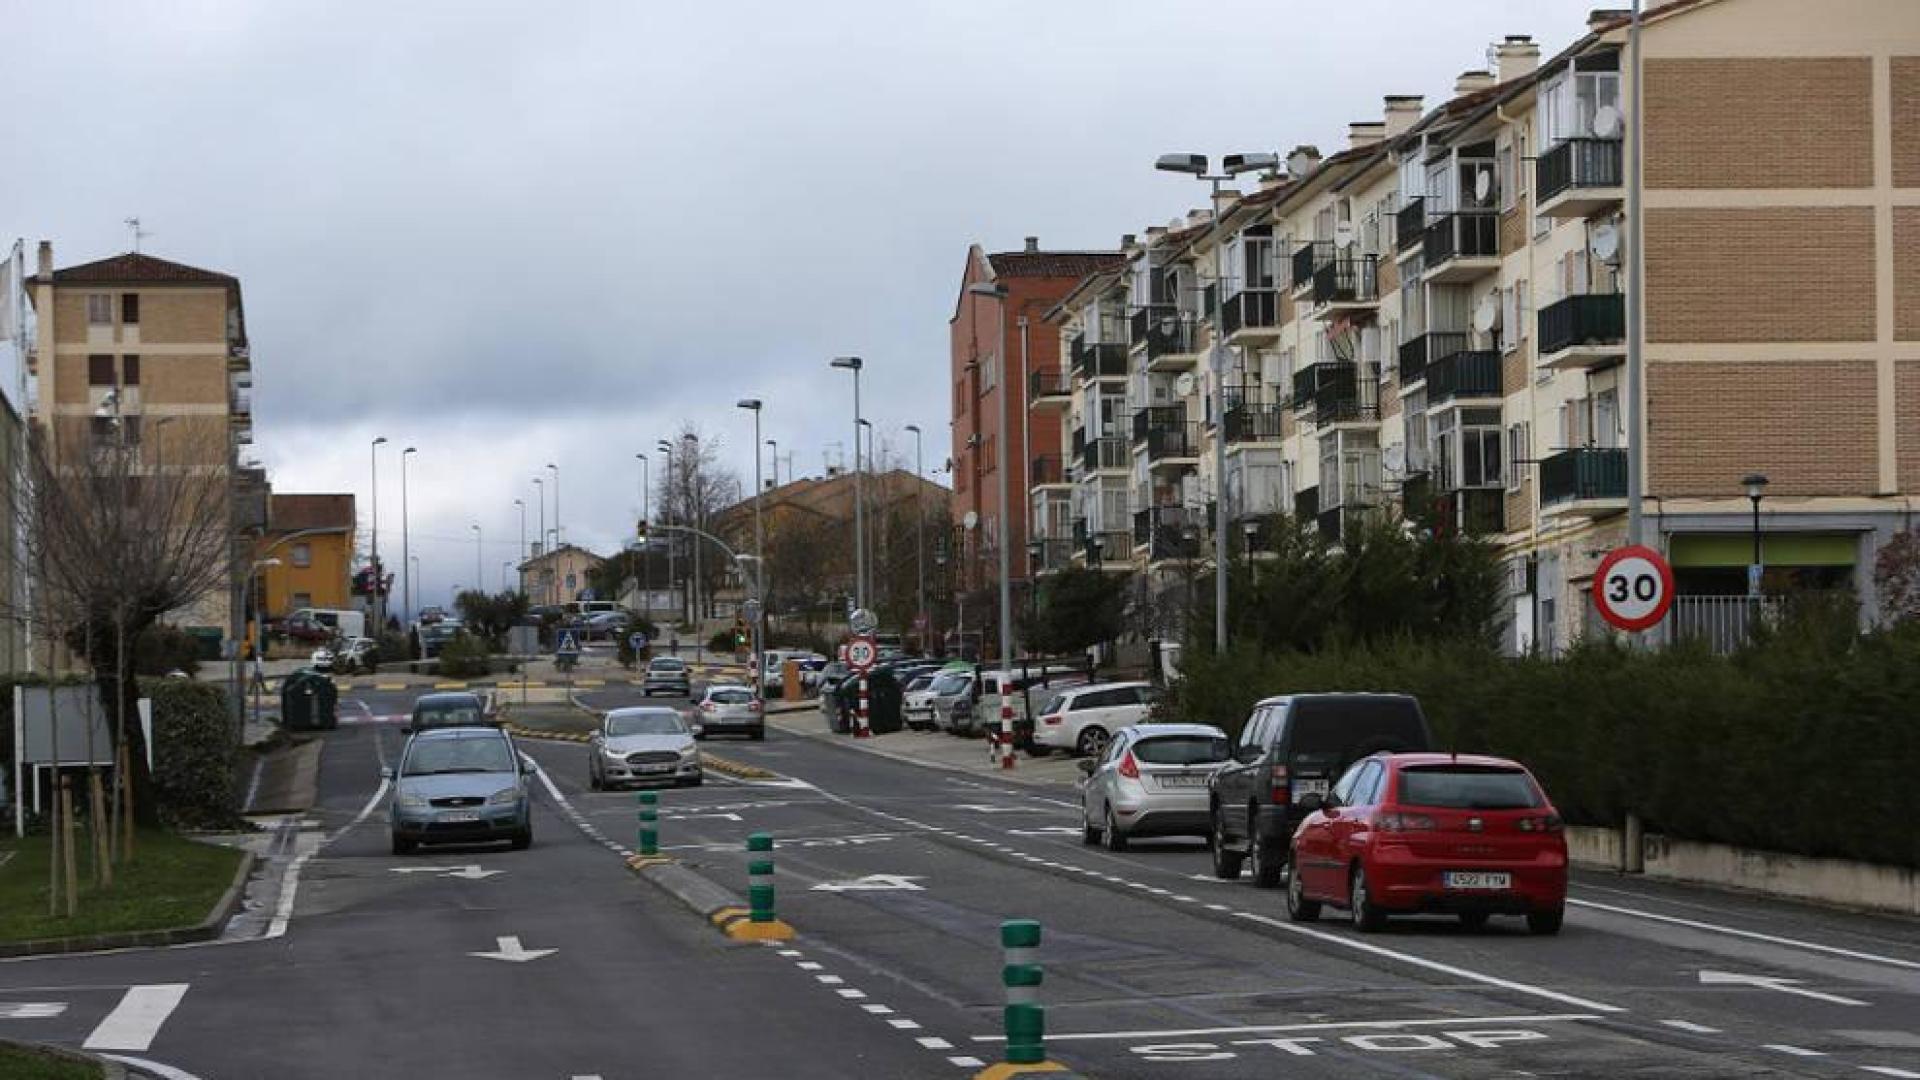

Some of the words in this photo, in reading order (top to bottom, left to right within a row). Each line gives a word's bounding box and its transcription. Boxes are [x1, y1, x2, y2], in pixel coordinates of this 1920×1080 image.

[1608, 574, 1657, 602] 30
[852, 646, 870, 661] 30
[1130, 1029, 1548, 1062] STOP
